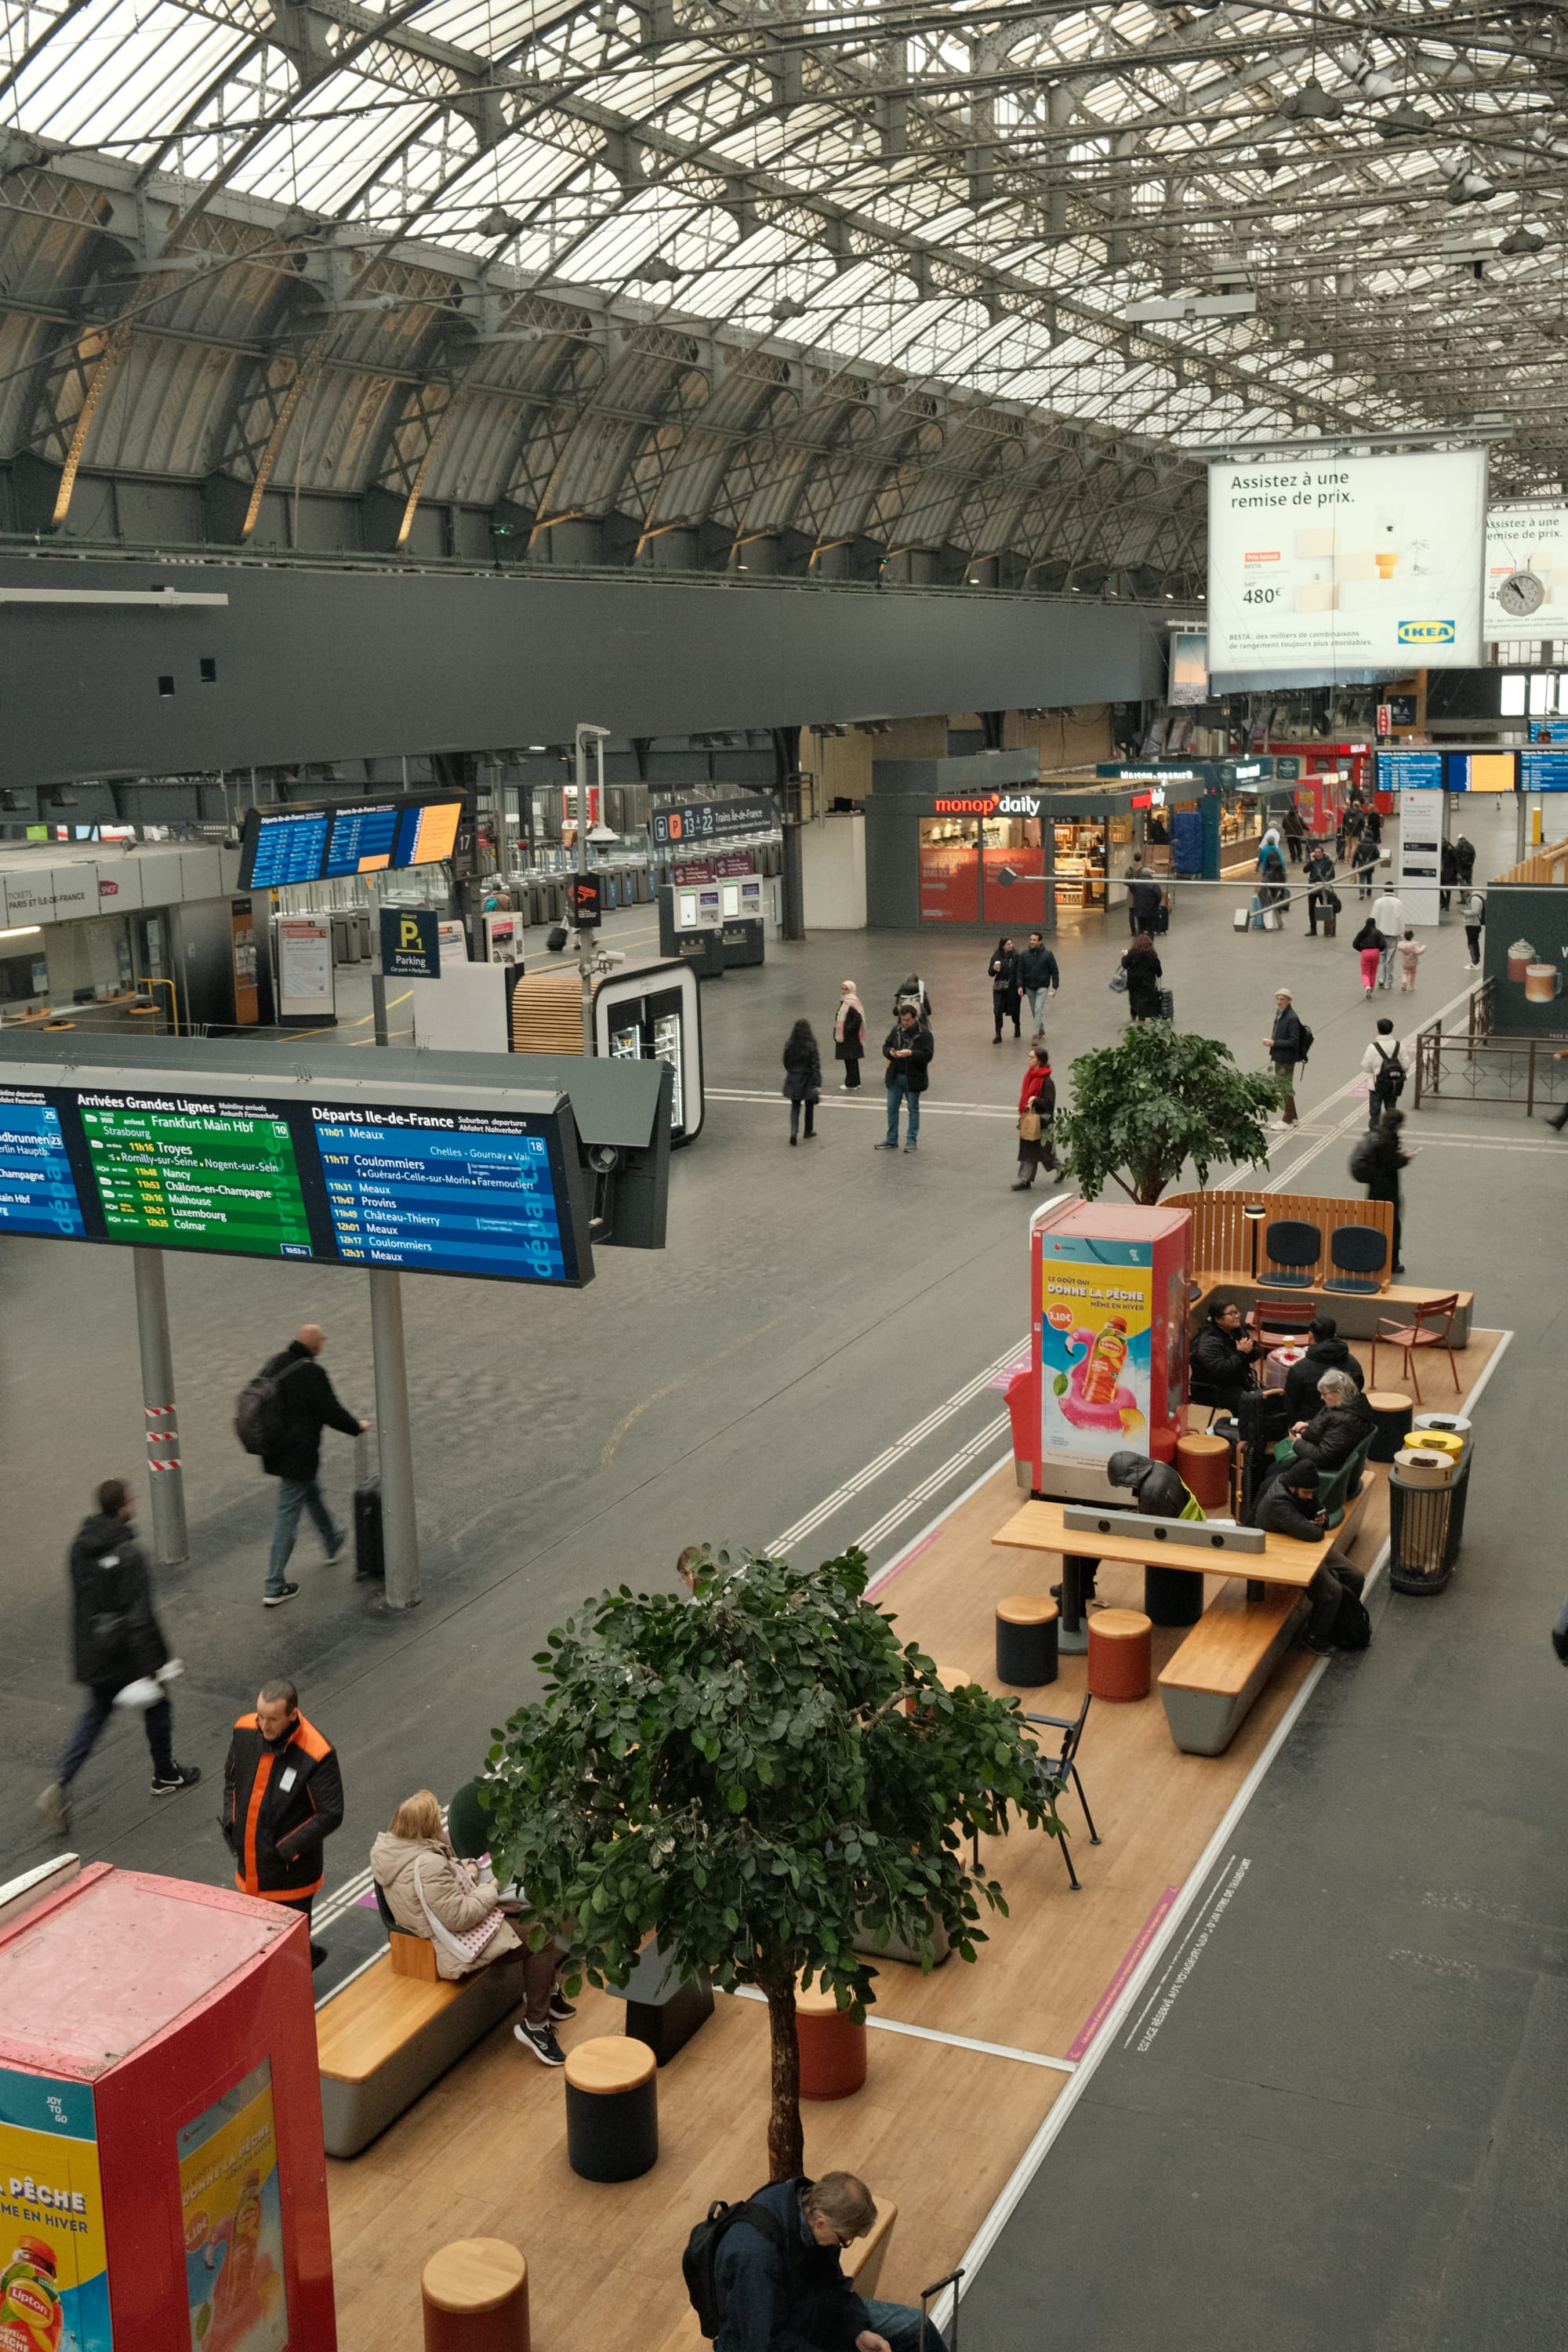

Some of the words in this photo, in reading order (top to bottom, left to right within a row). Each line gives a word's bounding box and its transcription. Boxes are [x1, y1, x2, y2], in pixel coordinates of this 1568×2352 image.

[1231, 474, 1298, 489] Assistez
[1302, 472, 1312, 486] à
[1318, 473, 1349, 485] une
[1232, 493, 1287, 508] remise
[1292, 491, 1312, 505] de
[1318, 489, 1355, 508] prix.
[1529, 517, 1535, 527] à
[1538, 518, 1559, 527] une
[1487, 530, 1519, 541] emise
[1522, 529, 1535, 540] de
[1538, 528, 1563, 540] prix.
[1404, 627, 1450, 637] IKEA
[1240, 642, 1279, 650] rangement
[1281, 641, 1312, 649] toujours
[1313, 640, 1329, 648] plus
[684, 818, 695, 834] 13
[702, 815, 713, 831] 22
[715, 811, 731, 822] Trains
[408, 808, 424, 864] Information
[459, 834, 471, 851] 17
[8, 890, 32, 900] TICKETS
[100, 885, 117, 894] SNCF
[9, 900, 27, 909] PARIS
[29, 898, 36, 907] ET
[396, 955, 426, 968] Parking
[78, 1093, 125, 1108] Arrivées
[126, 1097, 175, 1111] Grandes
[176, 1099, 216, 1115] Lignes
[44, 1111, 56, 1120] 25
[312, 1107, 363, 1123] Départs
[365, 1111, 454, 1128] Ile-de-France
[458, 1116, 489, 1125] Suburban
[492, 1118, 527, 1127] departures
[151, 1115, 201, 1129] Frankfurt
[204, 1119, 231, 1131] Main
[233, 1120, 254, 1133] Hbf
[275, 1125, 287, 1135] 10
[459, 1124, 484, 1132] Abfahrt
[485, 1126, 522, 1134] Nahverkehr
[103, 1125, 151, 1140] Strasbourg
[319, 1128, 344, 1137] 11h01
[349, 1128, 385, 1140] Meaux
[530, 1142, 543, 1151] 18
[51, 1137, 62, 1146] 23
[129, 1142, 154, 1152] 11h16
[156, 1142, 193, 1157] Troyes
[430, 1147, 462, 1157] Chelles
[470, 1149, 506, 1161] Gournay
[120, 1152, 198, 1167] Romilly-sur-Seine
[323, 1155, 349, 1165] 11h17
[354, 1155, 425, 1170] Coulommiers
[135, 1167, 157, 1176] 11h48
[163, 1168, 191, 1181] Nancy
[367, 1169, 470, 1185] Guérard-Celle-sur-Morin
[138, 1180, 160, 1189] 11h53
[165, 1180, 272, 1200] Châlons-en-Champagne
[329, 1182, 352, 1191] 11h31
[359, 1183, 391, 1194] Meaux
[15, 1194, 31, 1204] Hbf
[141, 1193, 163, 1202] 12h16
[168, 1194, 212, 1206] Mulhouse
[332, 1196, 355, 1205] 11h47
[361, 1196, 397, 1209] Provins
[143, 1206, 165, 1215] 12h21
[171, 1206, 227, 1222] Luxembourg
[334, 1209, 358, 1218] 11h49
[364, 1210, 439, 1227] Château-Thierry
[146, 1218, 169, 1227] 12h35
[174, 1219, 206, 1231] Colmar
[337, 1222, 360, 1232] 12h01
[367, 1223, 398, 1235] Meaux
[339, 1236, 362, 1245] 12h17
[369, 1236, 432, 1251] Coulommiers
[341, 1249, 365, 1258] 12h31
[371, 1250, 403, 1261] Meaux
[1048, 1284, 1087, 1297] DONNE
[1089, 1289, 1104, 1299] LA
[1107, 1287, 1144, 1302] PÊCHE
[1091, 1300, 1111, 1308] MÊME
[46, 2096, 62, 2106] JOY
[49, 2105, 62, 2114] TO
[55, 2115, 68, 2123] GO
[9, 2176, 86, 2215] PÊCHE
[23, 2208, 41, 2221] EN
[45, 2213, 88, 2234] HIVER
[12, 2288, 47, 2315] Lipton
